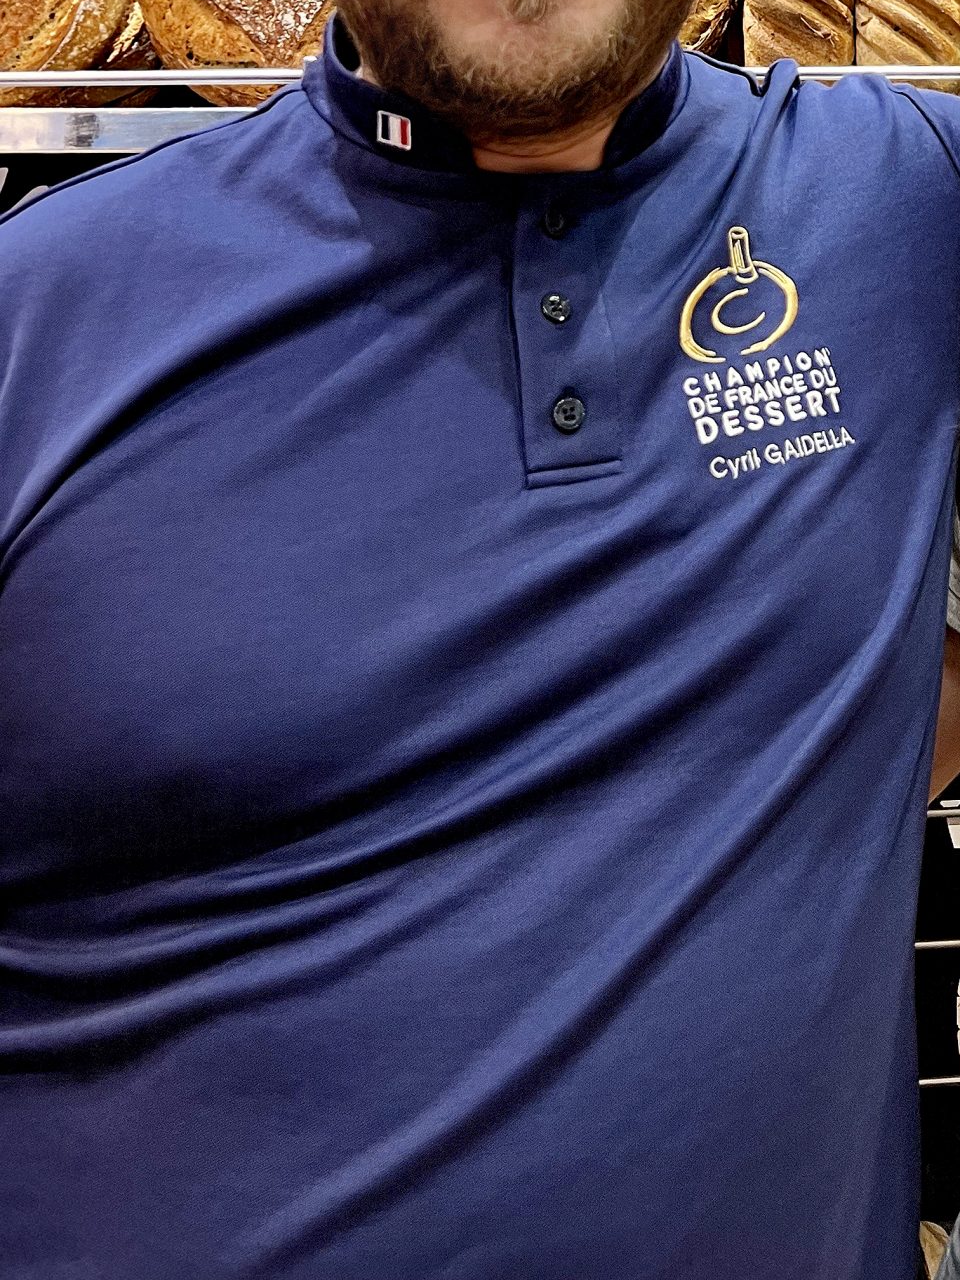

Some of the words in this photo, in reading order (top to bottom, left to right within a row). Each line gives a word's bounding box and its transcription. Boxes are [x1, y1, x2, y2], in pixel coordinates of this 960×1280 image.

[683, 347, 832, 397] CHAMPION
[688, 393, 722, 419] DE
[724, 372, 808, 411] FRANCE
[810, 366, 837, 389] DU
[695, 386, 842, 446] DESSERT
[709, 448, 761, 480] Cyril
[764, 426, 856, 465] GAIDELLA
